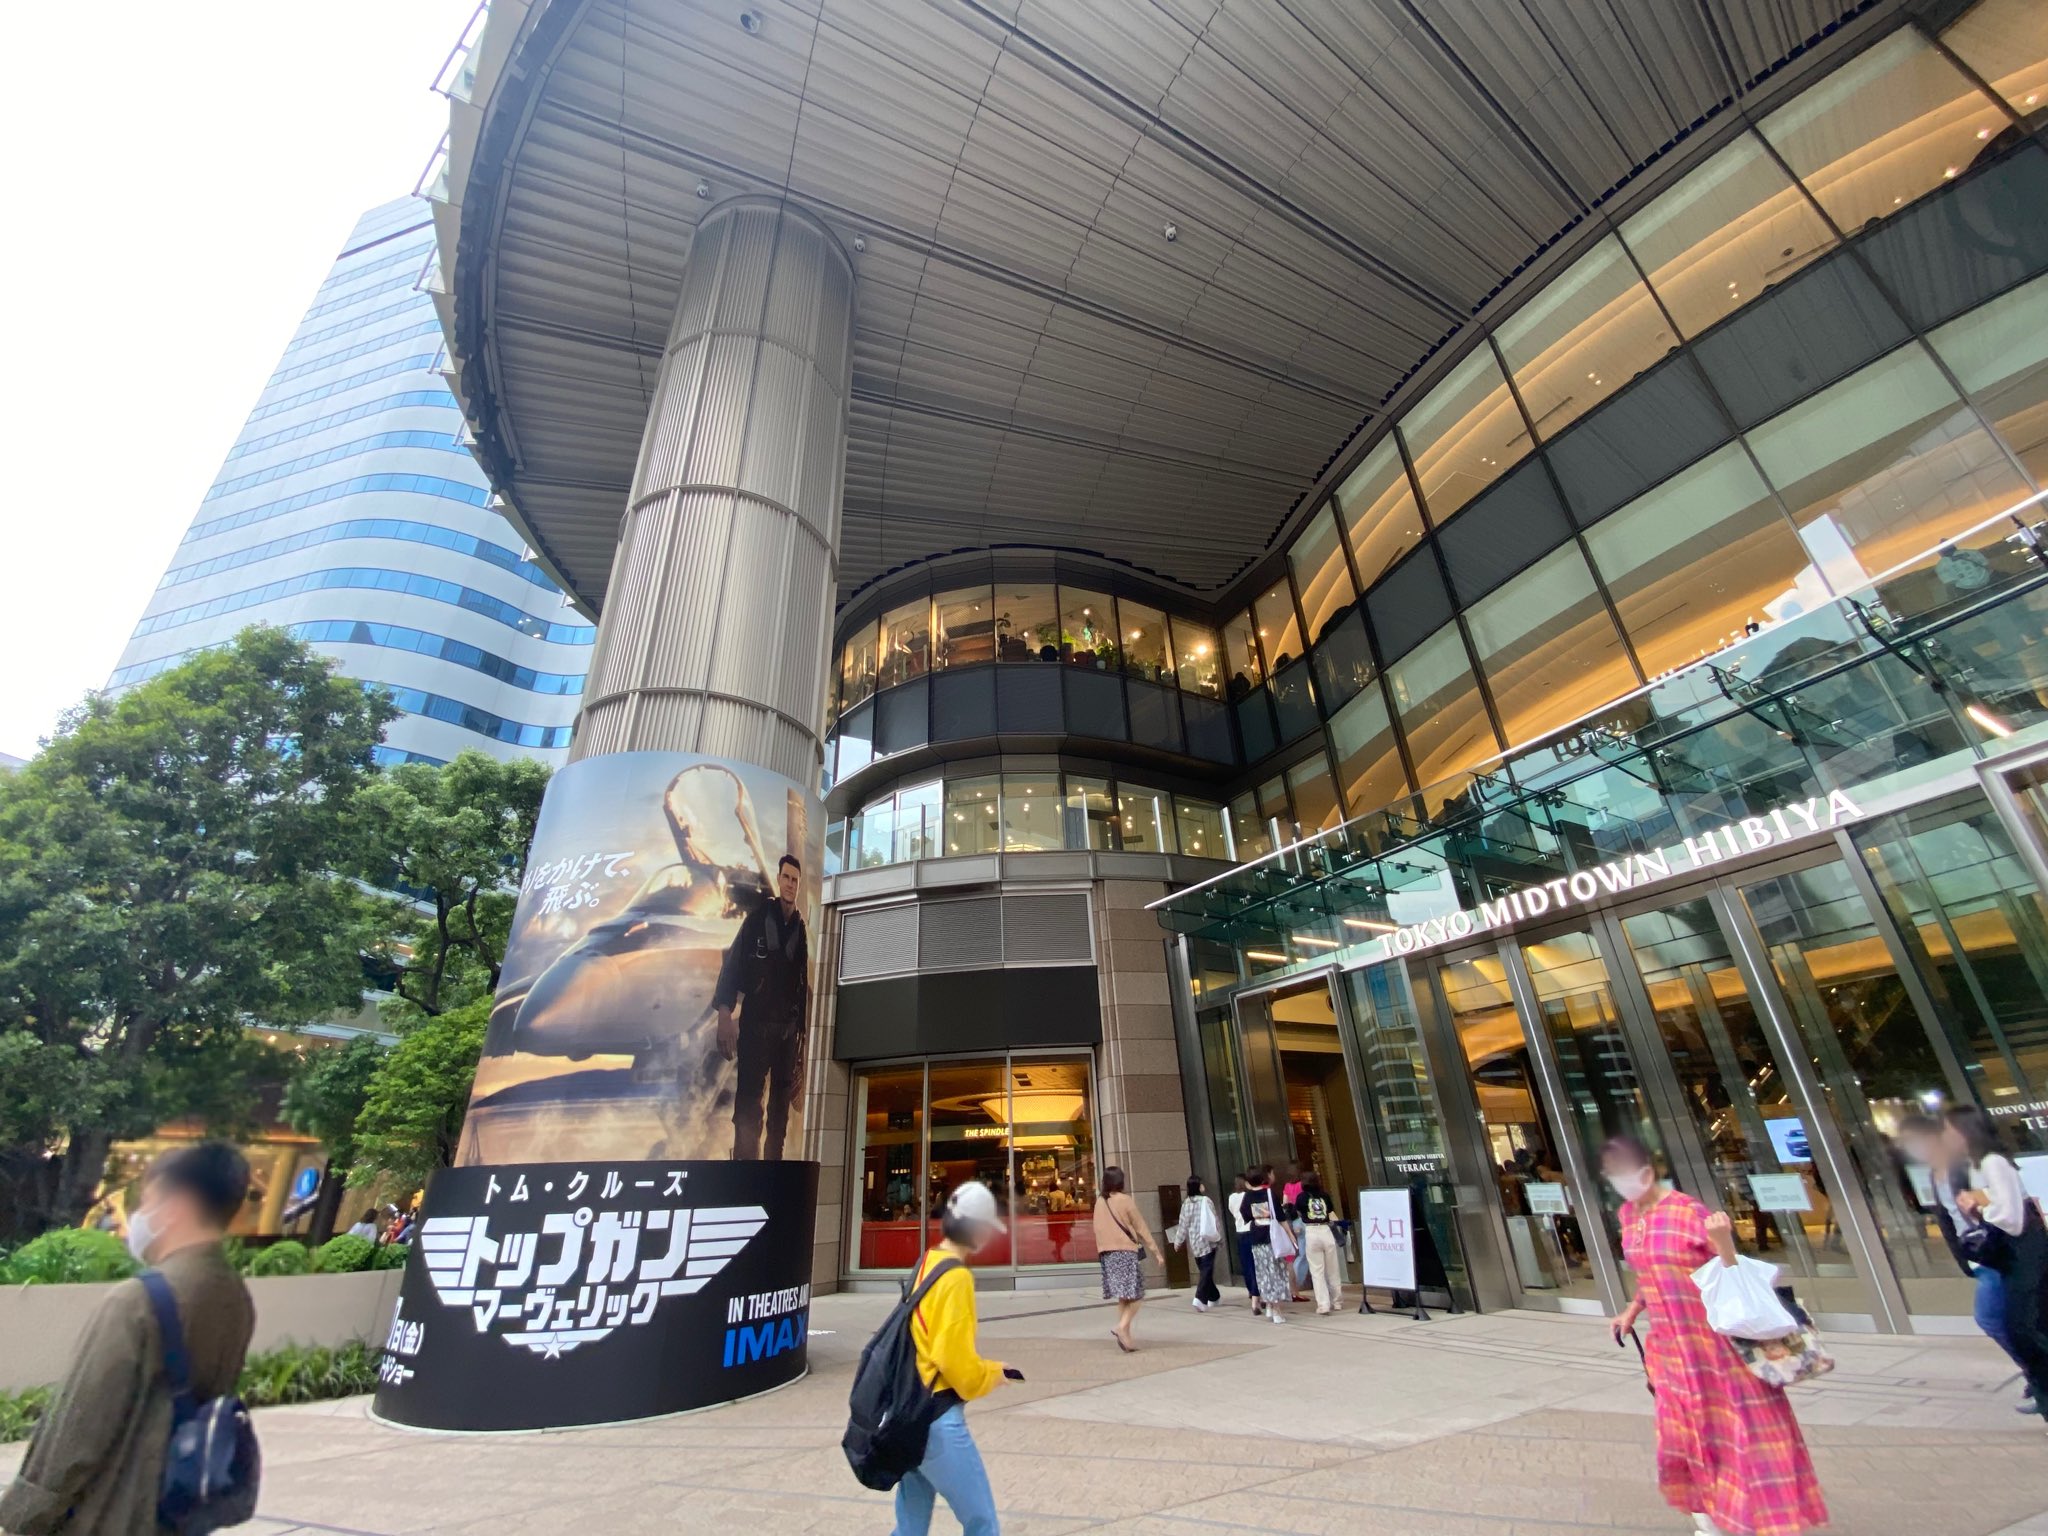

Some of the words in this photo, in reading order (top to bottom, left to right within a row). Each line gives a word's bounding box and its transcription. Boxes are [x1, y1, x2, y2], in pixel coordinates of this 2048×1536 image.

[1378, 911, 1472, 956] TOKYO
[1481, 847, 1671, 928] MIDTOWN
[1684, 790, 1864, 866] HIBIYA
[538, 881, 600, 916] 飛ぶ。
[1986, 1104, 2027, 1115] TOKYO
[2020, 1115, 2048, 1130] TE
[965, 1129, 979, 1137] THE
[979, 1127, 1010, 1137] SPINDLE
[1397, 1162, 1435, 1172] TERRACE
[484, 1170, 688, 1204] トム・クルーズ
[1368, 1216, 1405, 1240] 入口
[461, 1206, 691, 1287] トップガン
[1370, 1242, 1405, 1252] ENTRANCE
[473, 1281, 661, 1332] マーヴェリック
[727, 1296, 745, 1324] IN
[748, 1286, 799, 1320] THEATRES
[723, 1312, 808, 1368] IMAX
